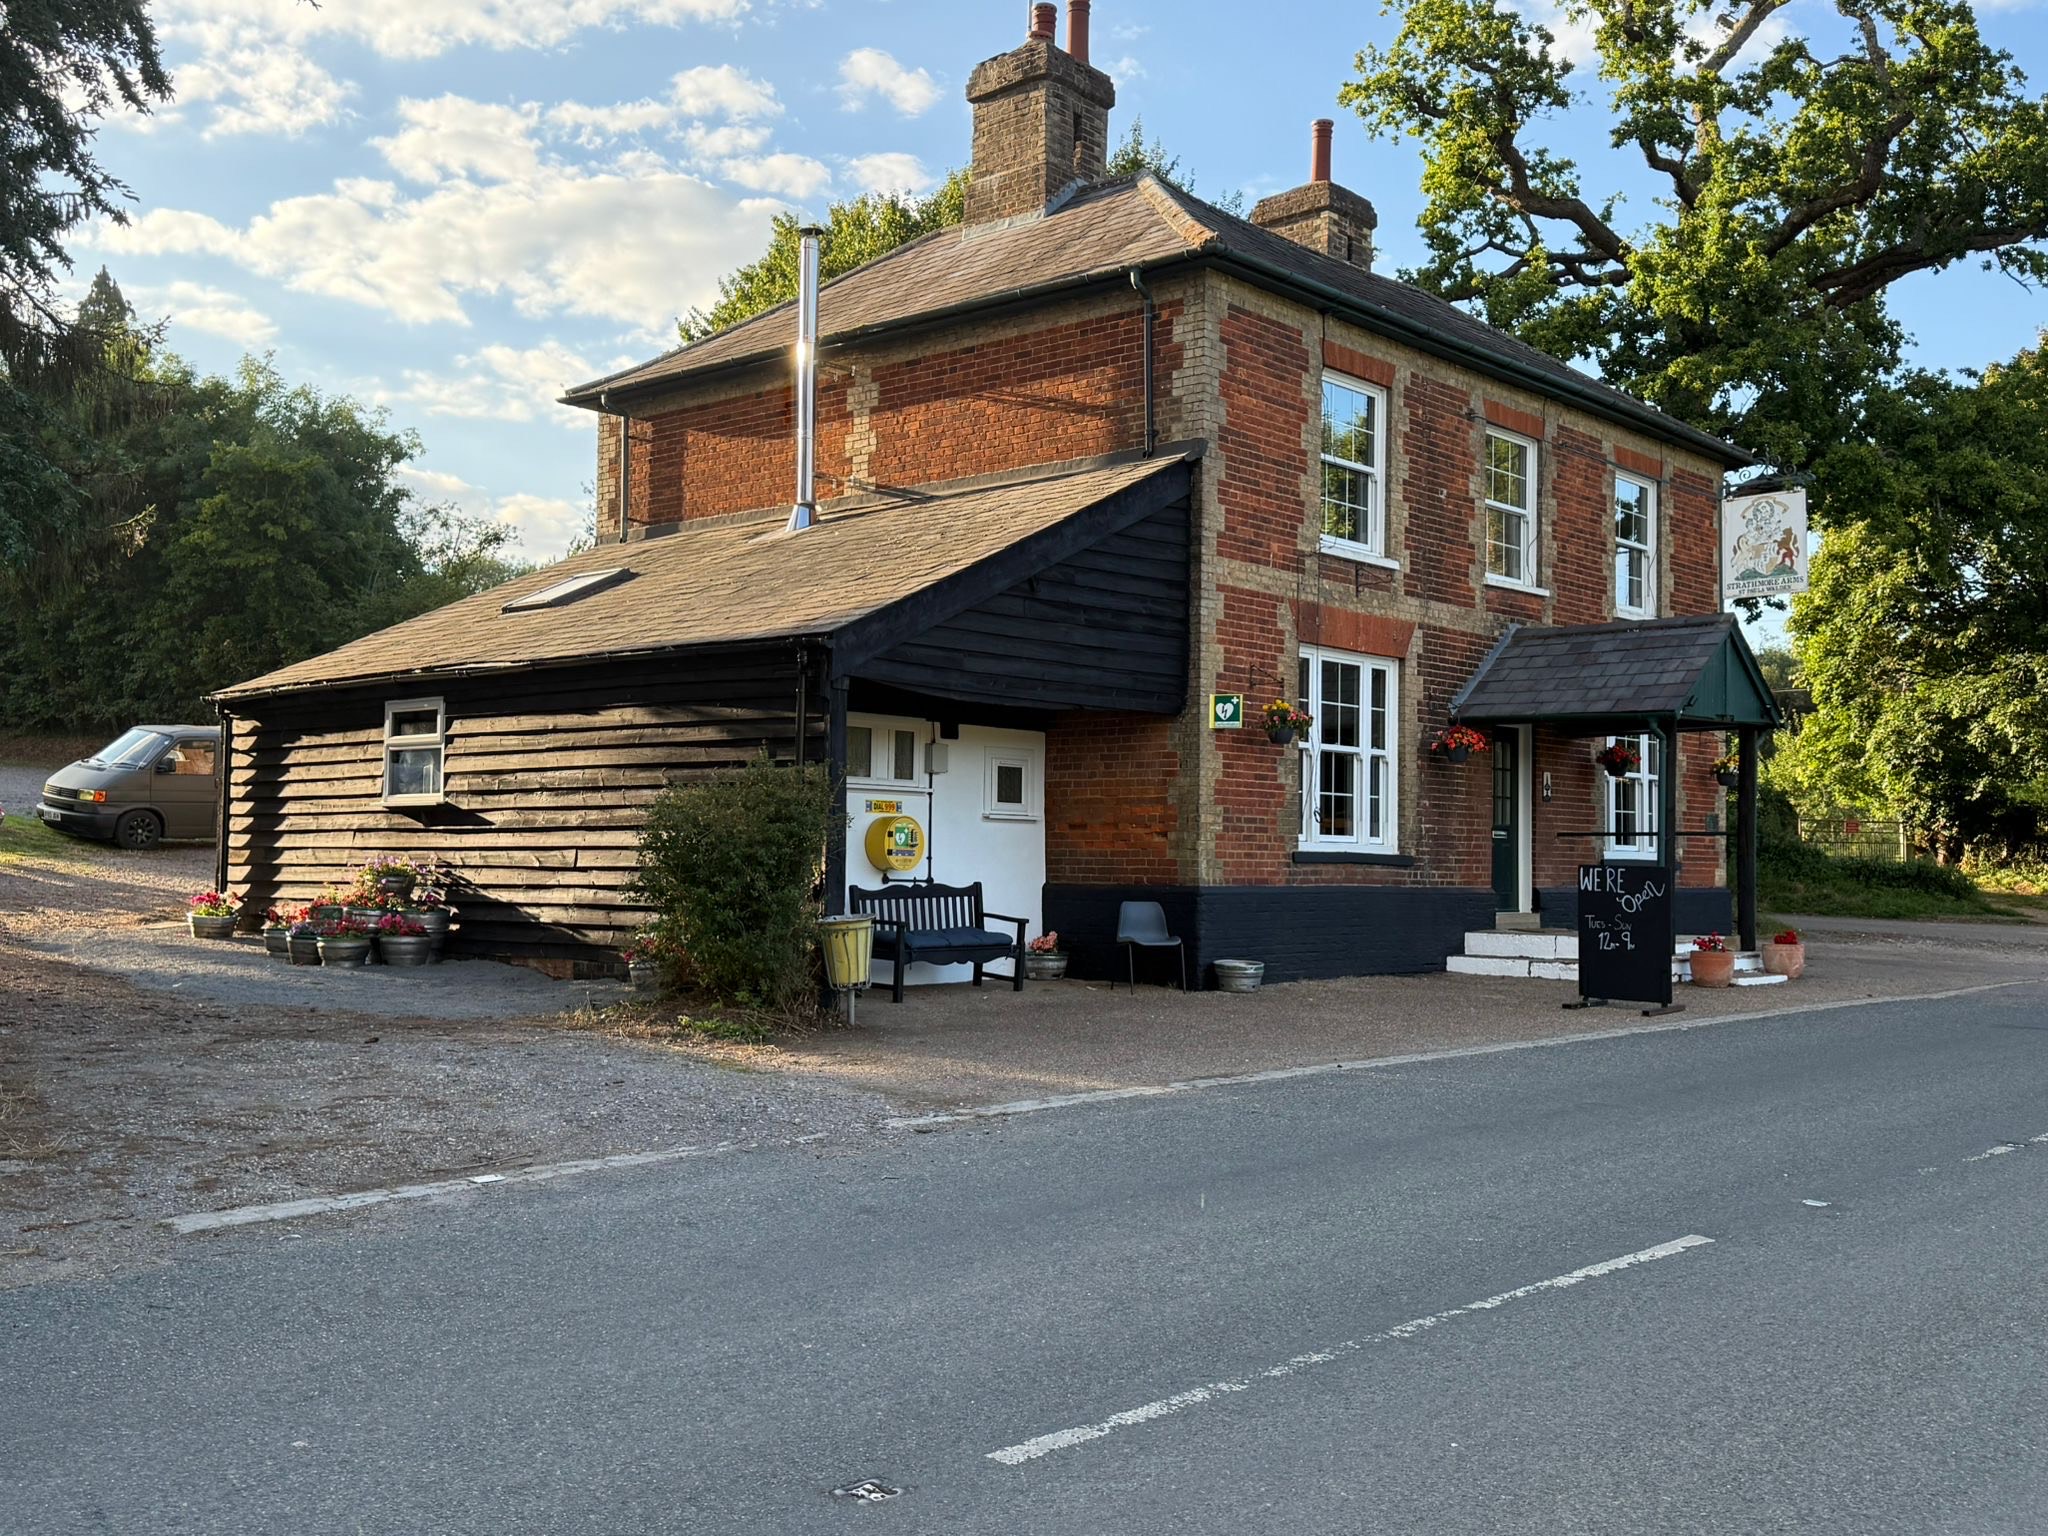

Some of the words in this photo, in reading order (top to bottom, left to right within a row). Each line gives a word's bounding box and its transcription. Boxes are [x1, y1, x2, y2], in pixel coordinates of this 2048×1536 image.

[1726, 578, 1780, 590] STRATHMORE
[1780, 576, 1804, 585] ARMS
[873, 802, 884, 810] DIAL
[884, 803, 895, 811] 999
[1580, 866, 1626, 893] WE'RE
